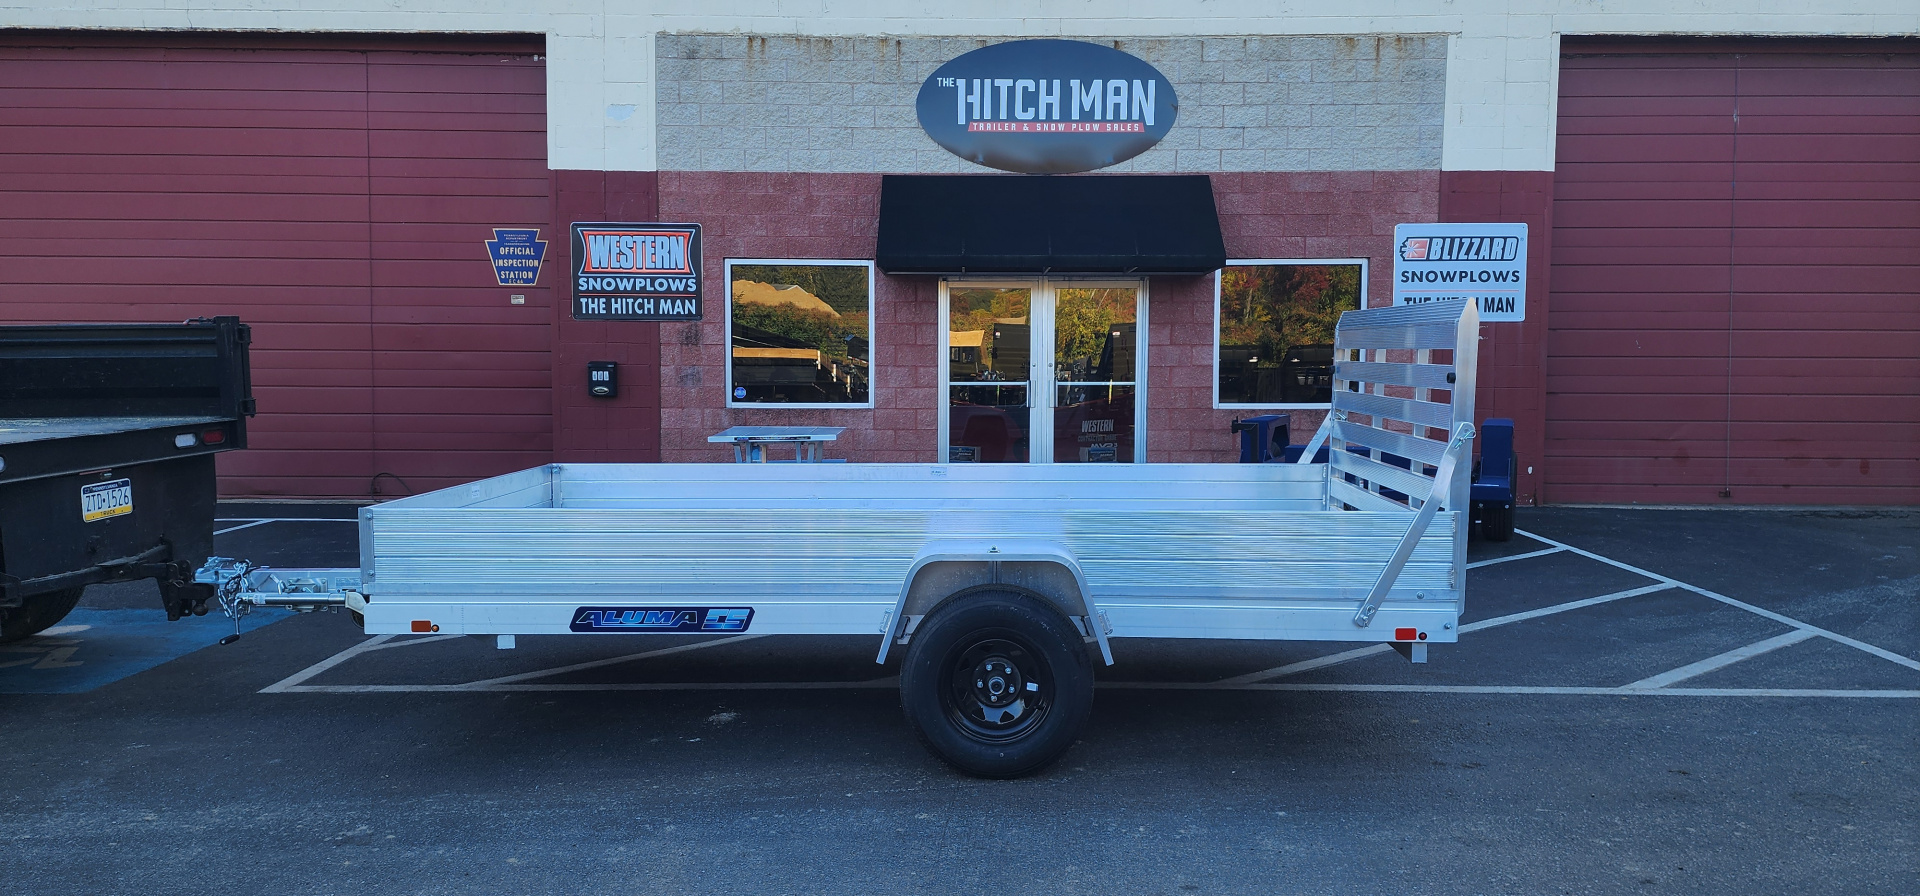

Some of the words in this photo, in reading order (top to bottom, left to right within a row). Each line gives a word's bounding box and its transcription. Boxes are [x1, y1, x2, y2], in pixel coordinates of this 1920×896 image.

[937, 77, 955, 87] THE
[956, 78, 1061, 125] HITCH
[1070, 79, 1156, 126] MAN
[973, 122, 1016, 131] TRAILER
[1023, 123, 1029, 131] &
[1036, 123, 1066, 131] SNOW
[1071, 123, 1100, 131] PLOW
[1106, 123, 1140, 131] SALES
[499, 247, 535, 256] OFFICIAL
[588, 234, 685, 270] WESTERN
[1429, 237, 1518, 260] BLIZZARD
[495, 259, 539, 267] INSPECTION
[500, 271, 533, 279] STATION
[1400, 270, 1520, 283] SNOWPLOWS
[578, 277, 697, 292] SNOWPLOWS
[580, 297, 606, 314] THE
[611, 298, 654, 315] HITCH
[659, 298, 696, 315] MAN
[1483, 297, 1515, 313] MAN
[1081, 419, 1114, 433] WESTERN
[576, 611, 697, 627] ALUMA
